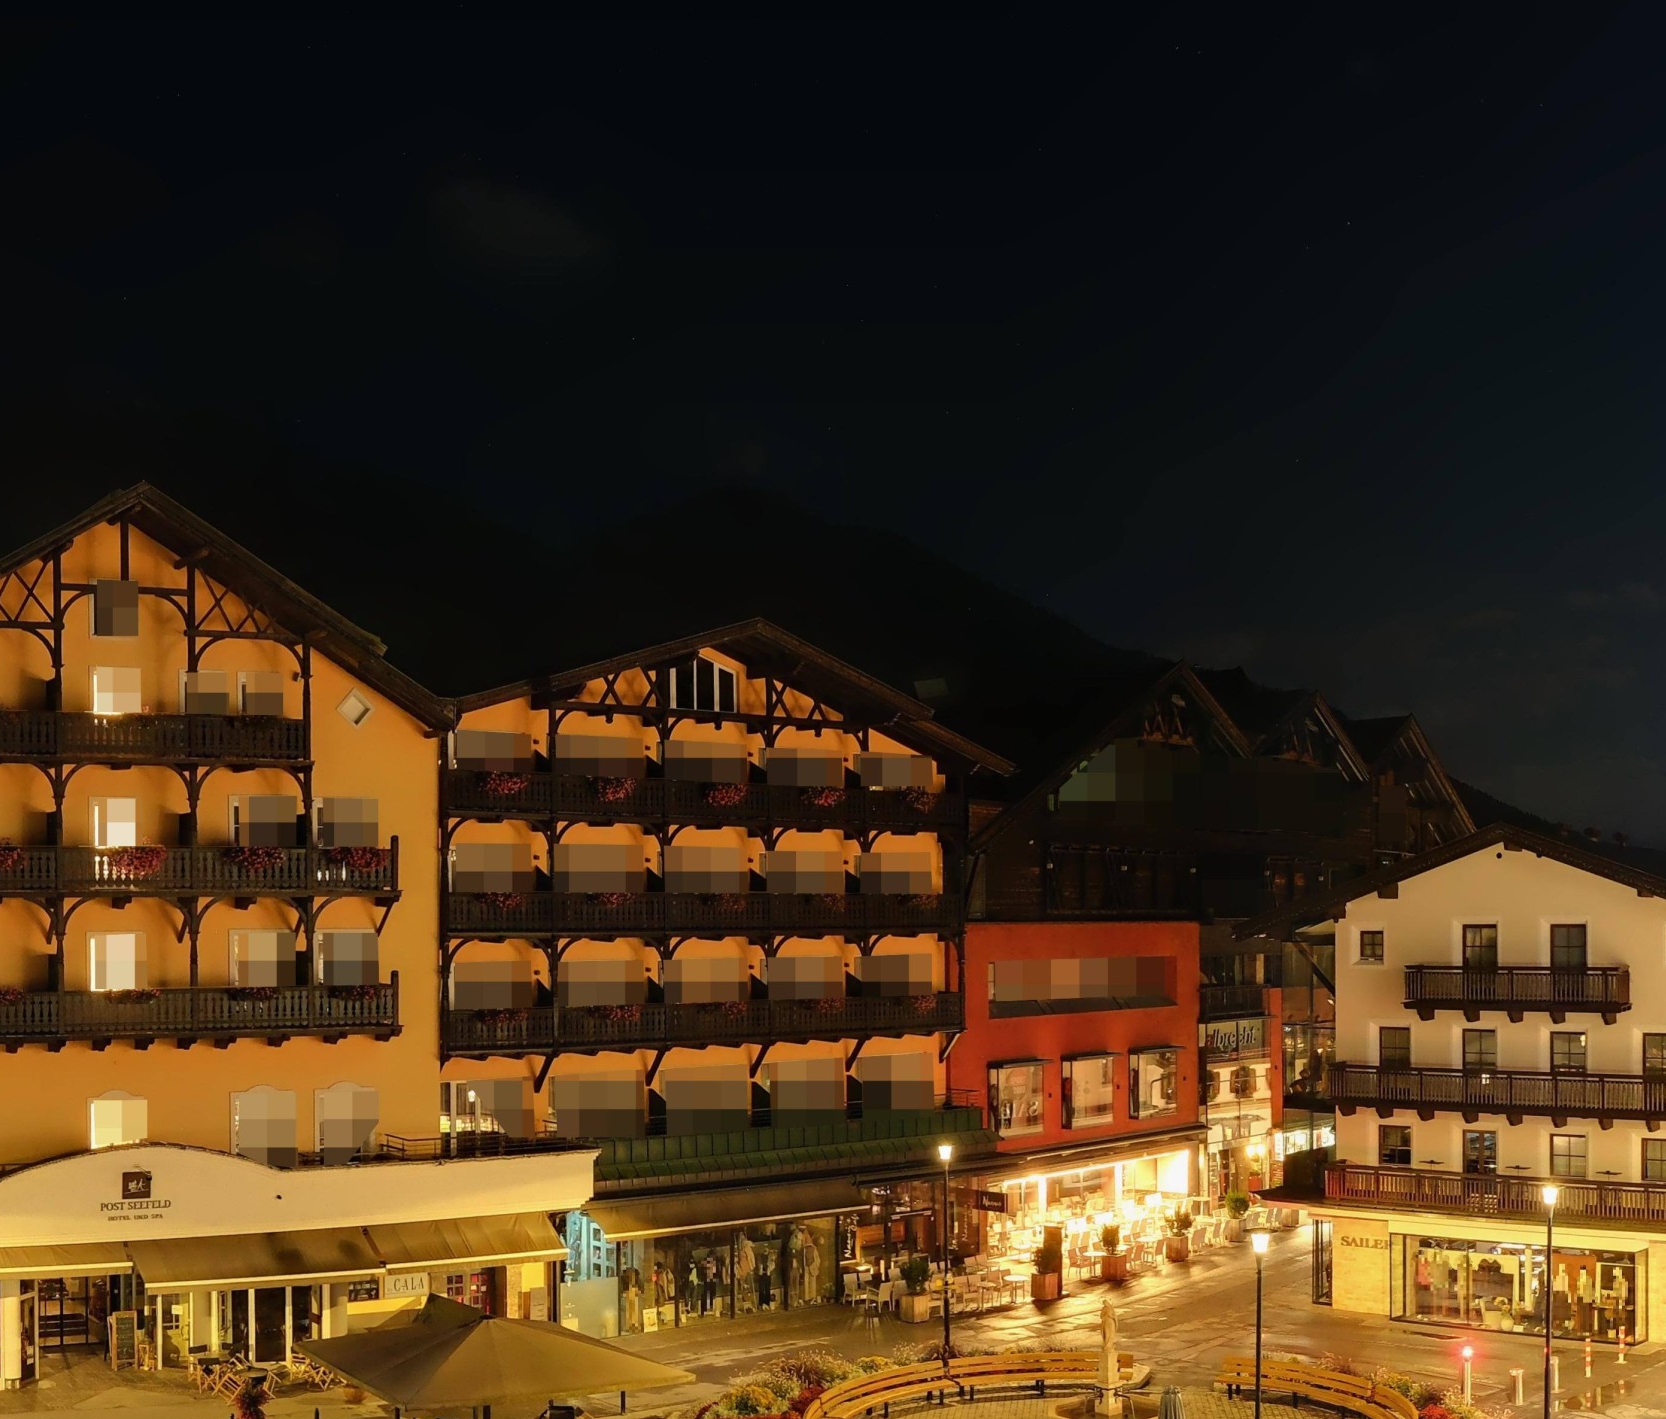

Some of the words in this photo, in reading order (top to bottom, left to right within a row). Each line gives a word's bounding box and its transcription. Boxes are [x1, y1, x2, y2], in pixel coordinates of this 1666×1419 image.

[100, 1202, 126, 1212] POST
[127, 1199, 171, 1210] SEEFELD
[393, 1276, 424, 1292] CALA
